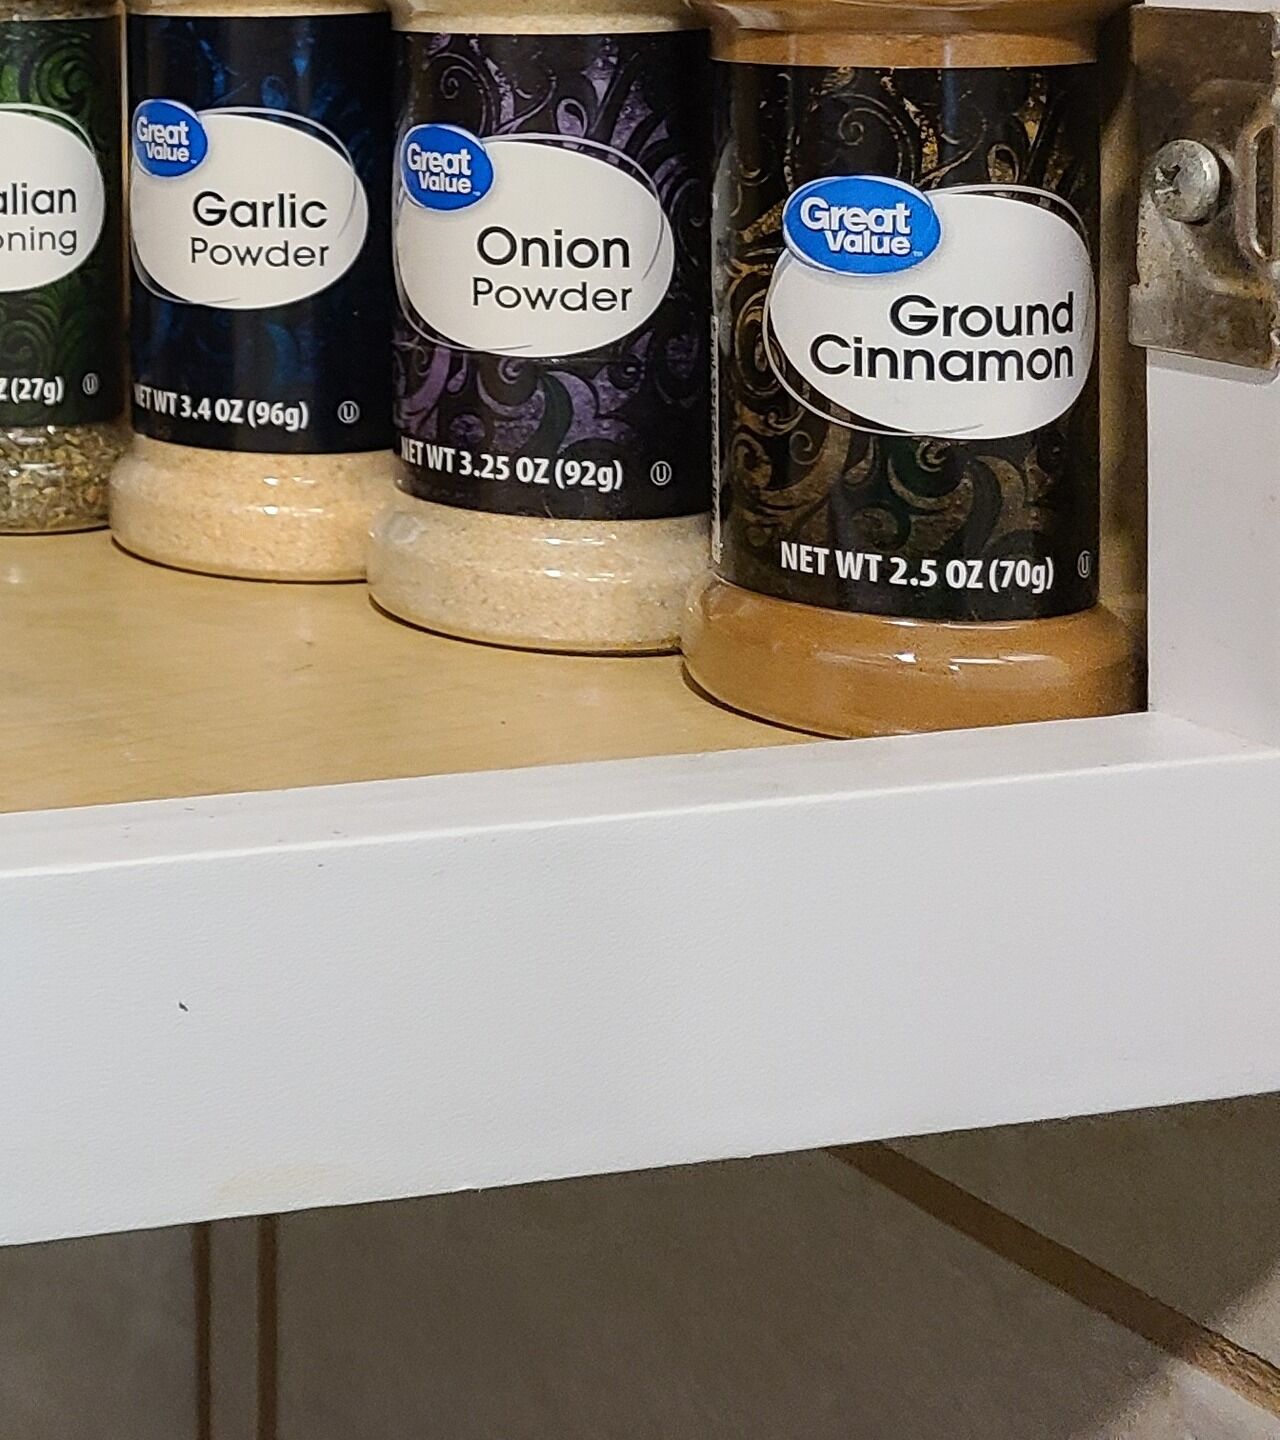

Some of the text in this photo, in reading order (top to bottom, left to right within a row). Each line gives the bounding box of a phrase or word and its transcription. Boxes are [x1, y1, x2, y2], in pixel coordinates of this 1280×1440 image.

[135, 117, 189, 146] Great
[145, 141, 189, 163] Value
[406, 142, 472, 177] Great
[418, 172, 472, 194] Value
[192, 190, 328, 229] Garlic
[799, 196, 911, 234] Great
[190, 236, 330, 268] Powder
[476, 226, 631, 268] Onion
[825, 229, 911, 257] Value
[472, 277, 632, 311] Powder
[889, 291, 1075, 337] Ground
[809, 333, 1075, 383] Cinnamon
[11, 375, 65, 405] (27g)
[152, 388, 178, 418] WT
[180, 394, 211, 421] 3.4
[214, 398, 244, 424] OZ
[247, 399, 308, 432] (96g)
[400, 435, 623, 493] NET WT 3.25 OZ (92g)
[780, 540, 1054, 594] NET WT 2.5 OZ (70g)
